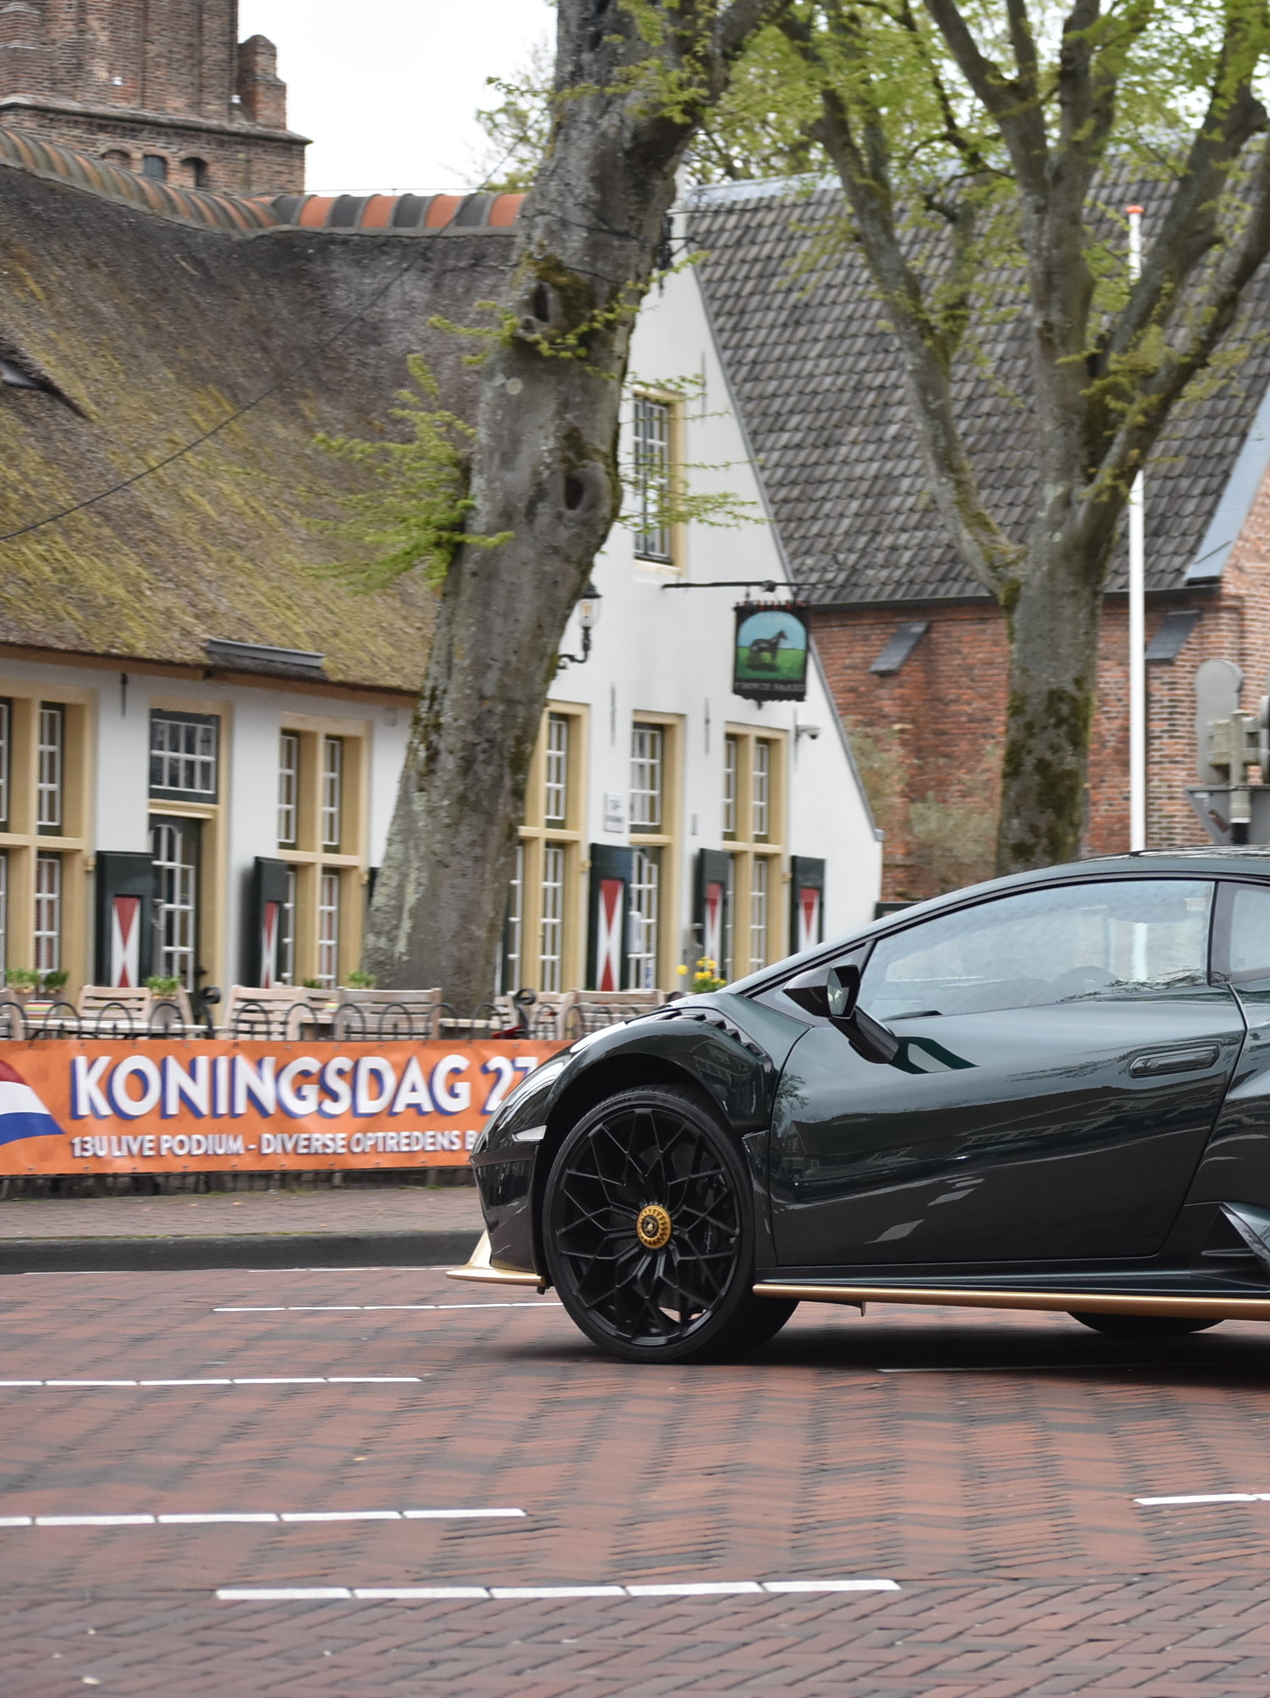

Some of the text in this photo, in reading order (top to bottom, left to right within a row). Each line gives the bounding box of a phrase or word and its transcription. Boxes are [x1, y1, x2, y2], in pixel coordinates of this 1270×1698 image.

[71, 1054, 471, 1119] KONINGSDAG
[71, 1135, 107, 1158] 13U
[110, 1134, 156, 1157] LIVE
[160, 1133, 244, 1156] PODIUM
[260, 1133, 348, 1154] DIVERSE
[350, 1130, 462, 1153] OPTREDENS
[465, 1129, 480, 1150] B
